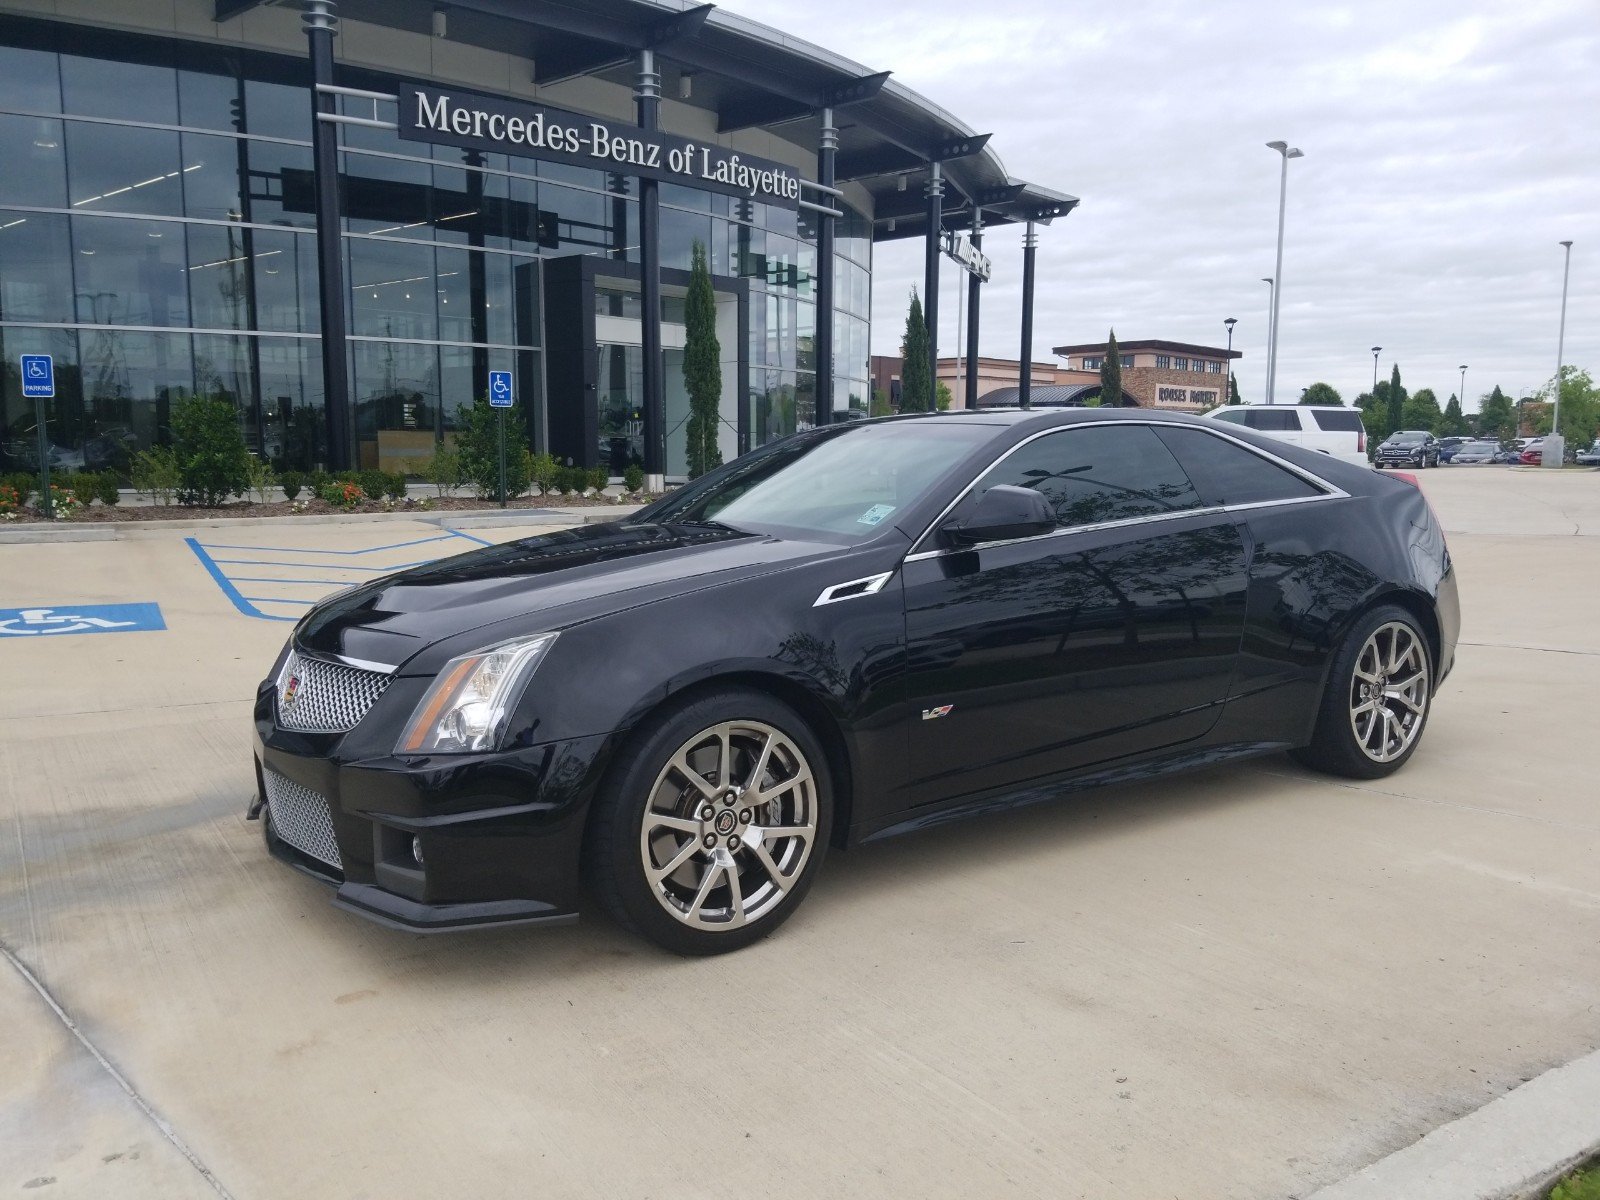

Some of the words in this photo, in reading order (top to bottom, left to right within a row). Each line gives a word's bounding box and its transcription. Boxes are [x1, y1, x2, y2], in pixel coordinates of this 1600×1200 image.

[414, 90, 661, 169] Mercedes-Benz
[669, 143, 695, 175] of
[700, 147, 799, 199] Lafayette
[1158, 387, 1187, 402] ROUSES
[1190, 389, 1218, 404] MARKET
